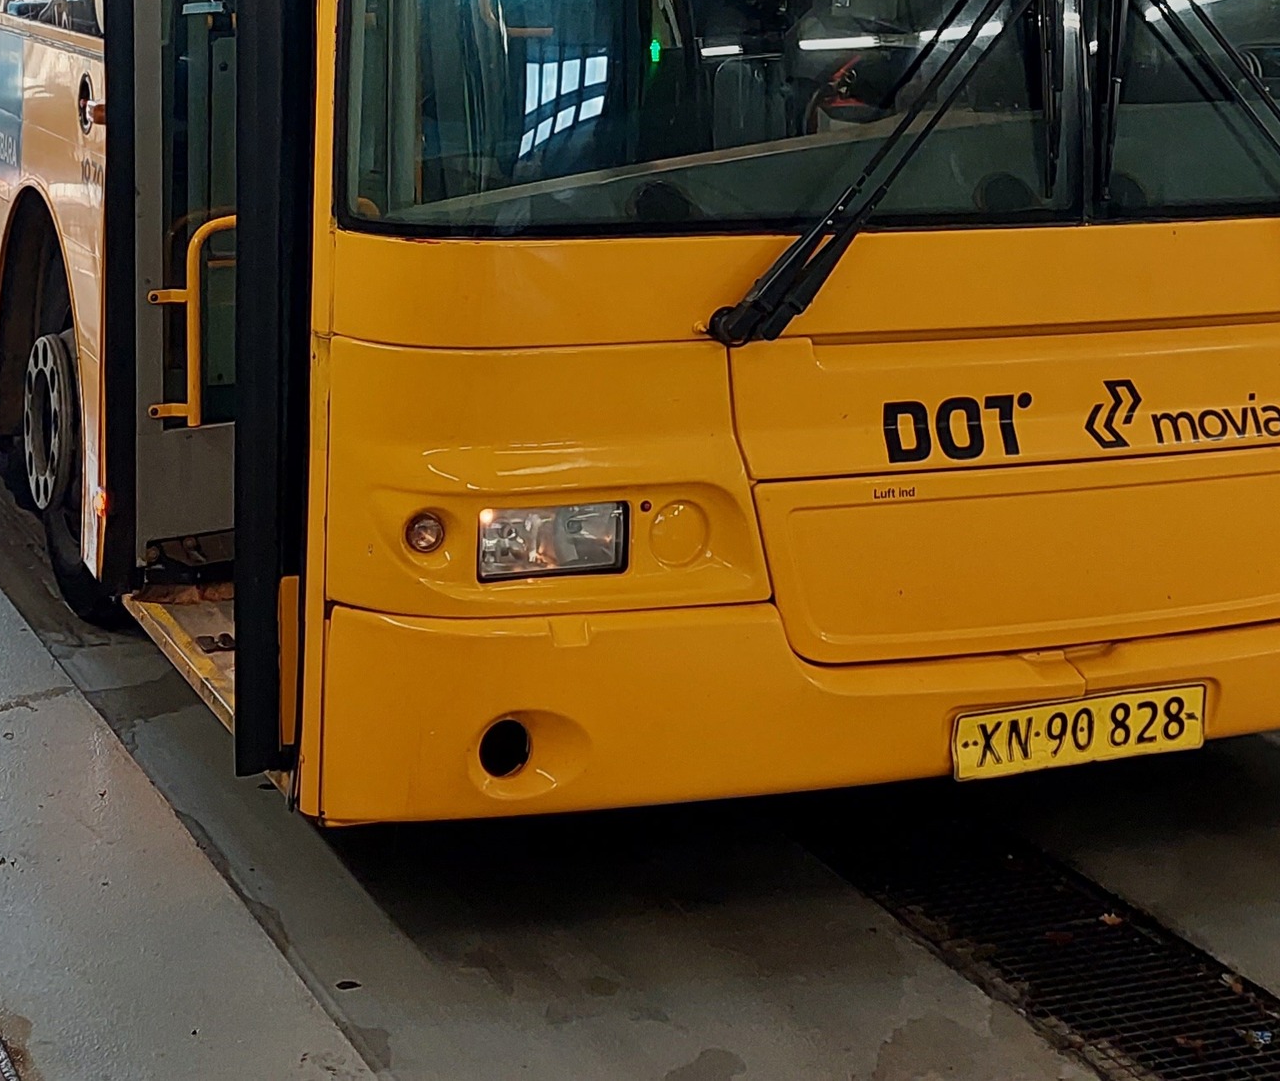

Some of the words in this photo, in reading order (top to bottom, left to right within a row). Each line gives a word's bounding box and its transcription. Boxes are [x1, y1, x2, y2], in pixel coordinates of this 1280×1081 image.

[883, 392, 1032, 463] DOT
[873, 487, 895, 499] Luft
[977, 717, 1034, 768] XN
[1046, 707, 1094, 757] 90
[1109, 696, 1186, 748] 828
